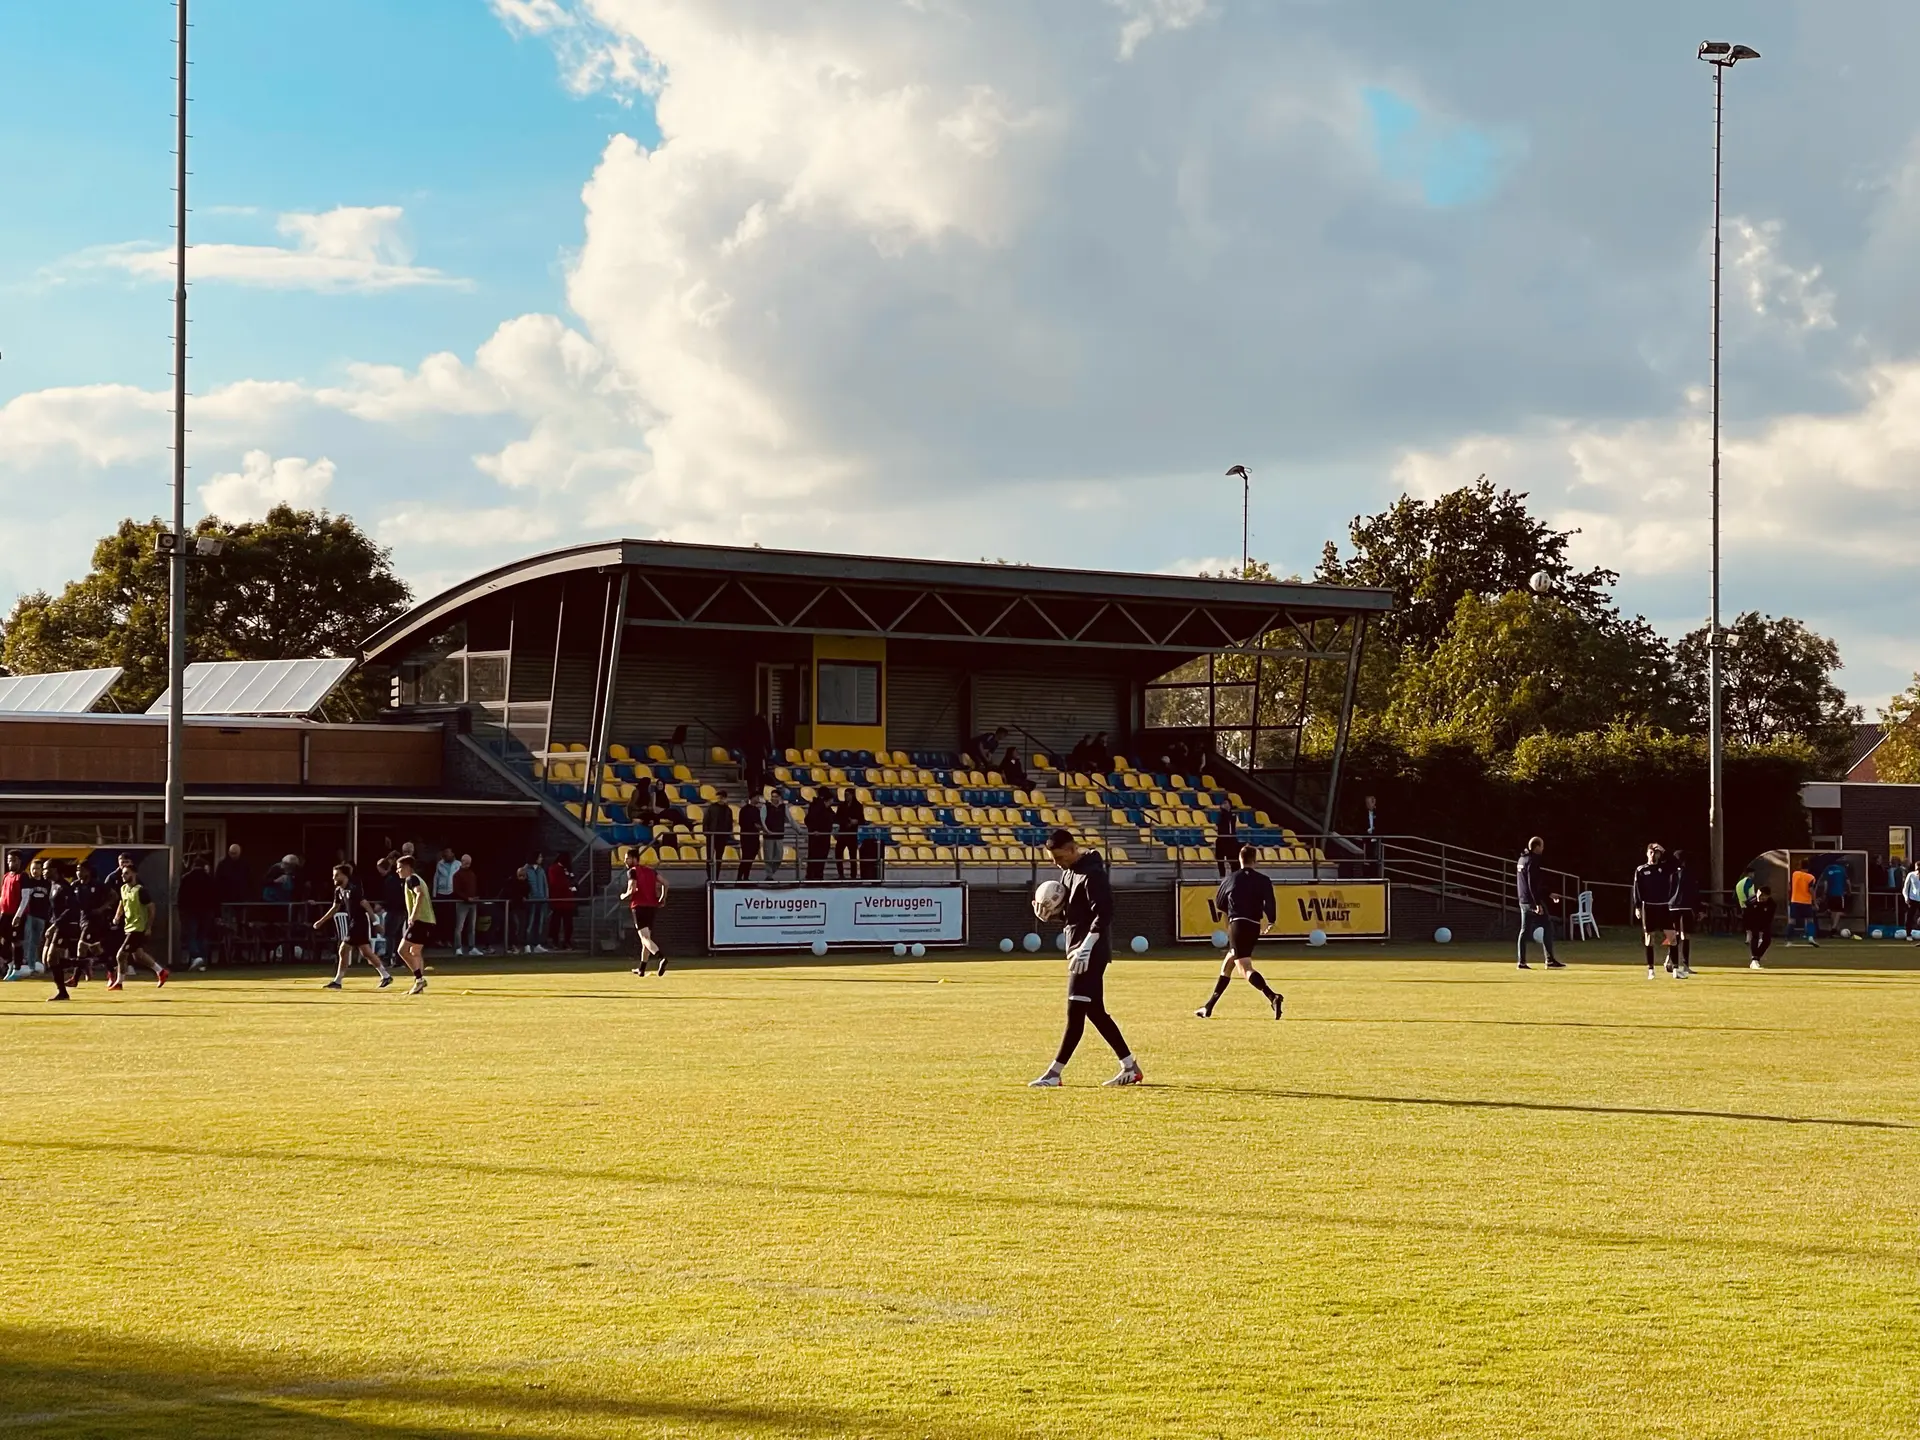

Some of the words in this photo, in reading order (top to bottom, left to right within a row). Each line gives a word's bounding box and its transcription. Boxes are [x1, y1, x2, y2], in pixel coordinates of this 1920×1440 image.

[744, 897, 817, 912] Verbruggen
[864, 896, 933, 911] Verbruggen
[1320, 898, 1337, 909] VAN
[1326, 910, 1351, 921] AALST
